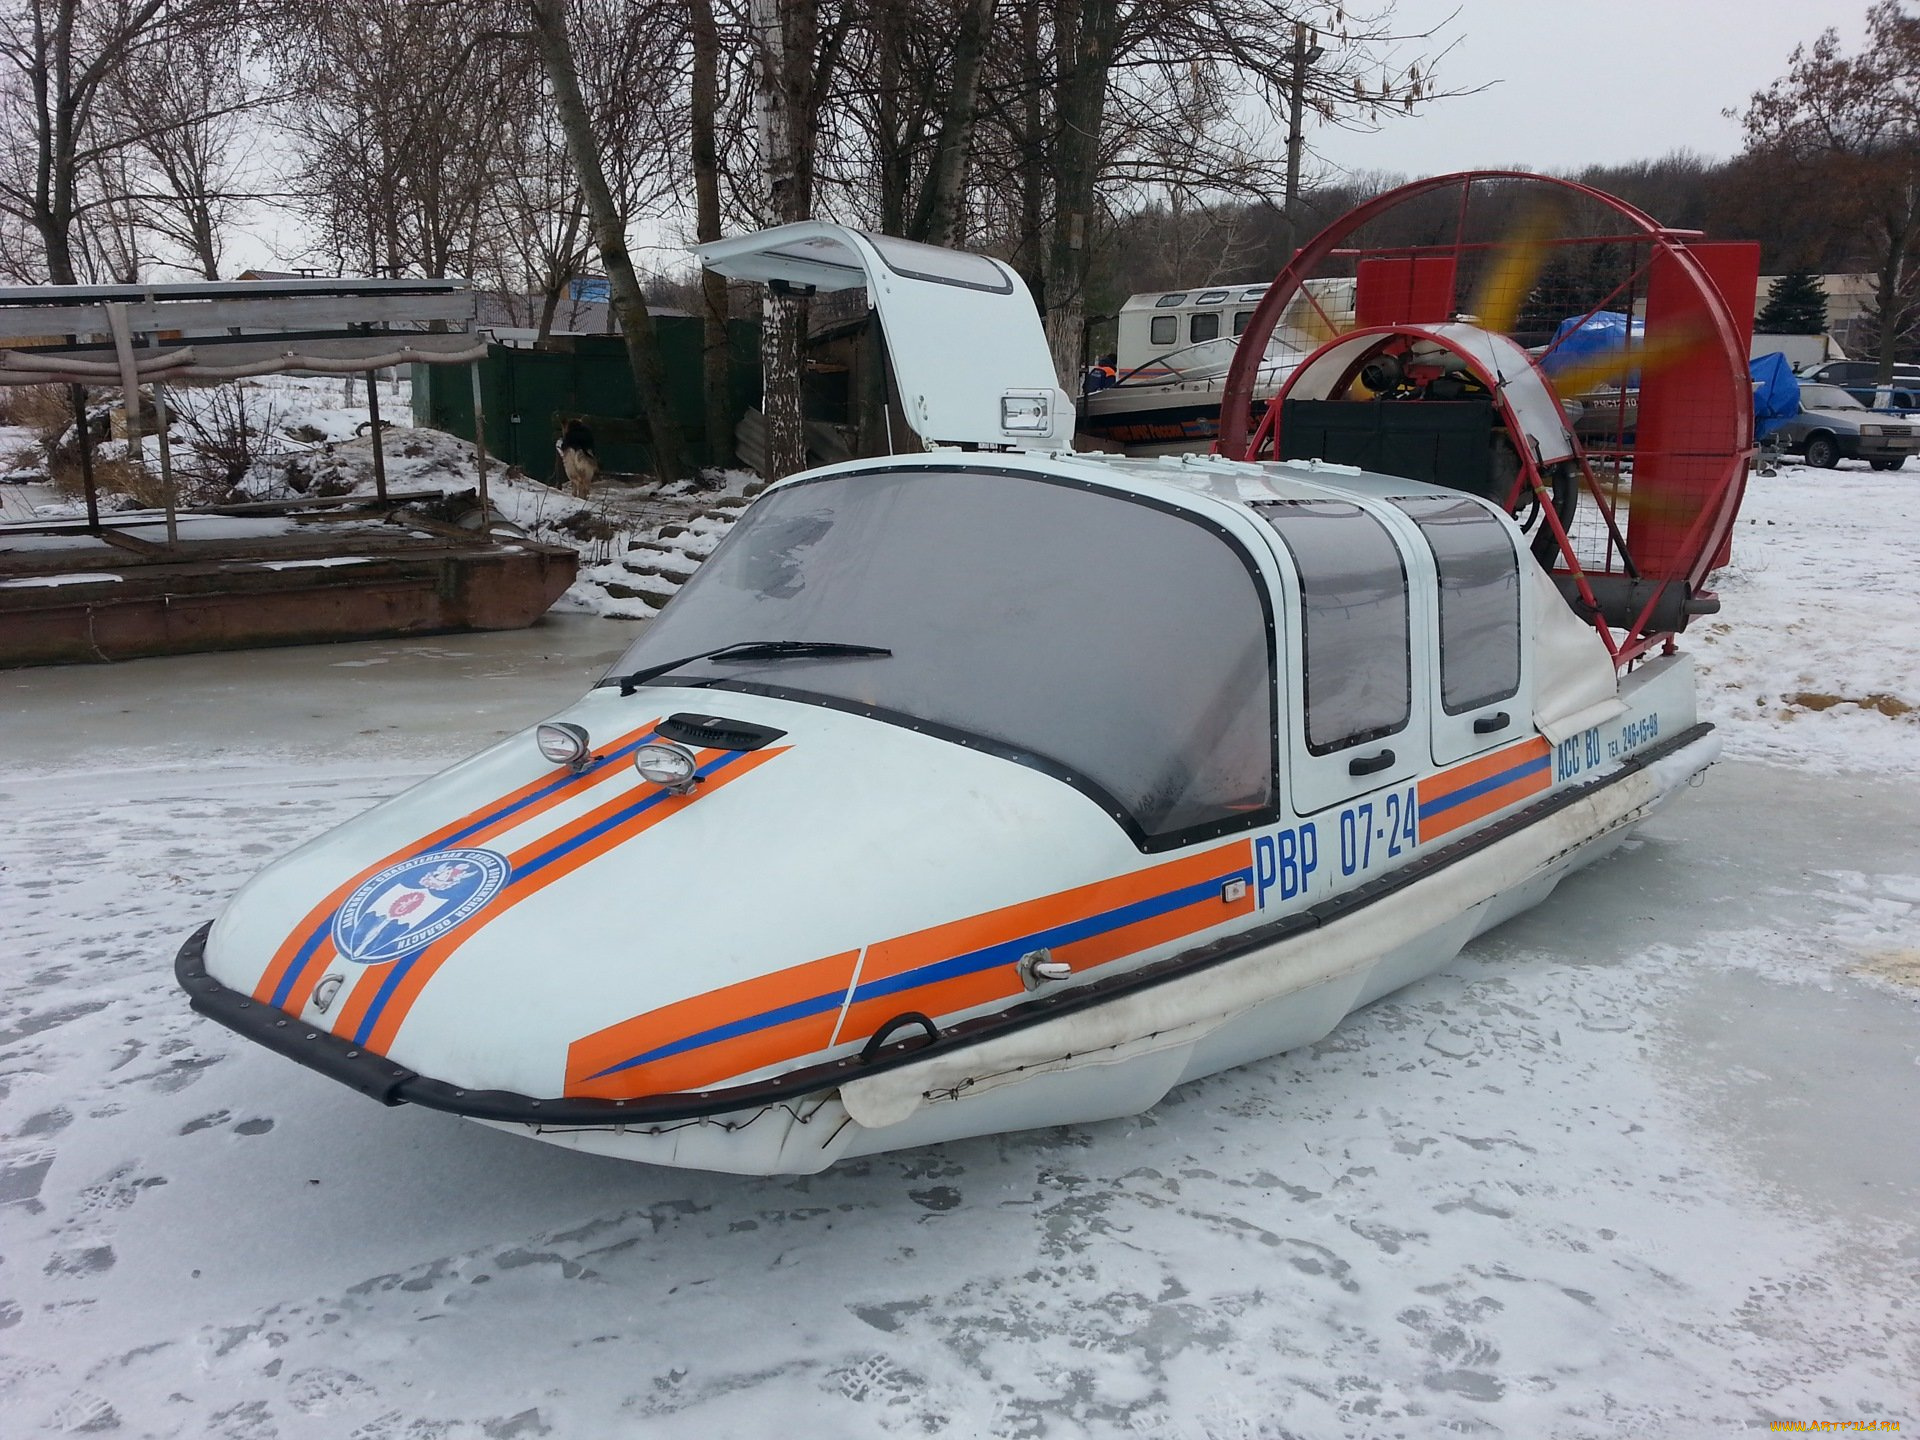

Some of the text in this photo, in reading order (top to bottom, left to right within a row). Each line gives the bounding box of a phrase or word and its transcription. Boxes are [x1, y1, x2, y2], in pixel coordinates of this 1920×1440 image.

[1558, 734, 1580, 783] АСС
[1585, 727, 1601, 770] ВО
[1622, 712, 1658, 753] 246-15-98
[1255, 786, 1416, 910] РВР 07-24
[397, 918, 451, 950] ОБЛАСТИ
